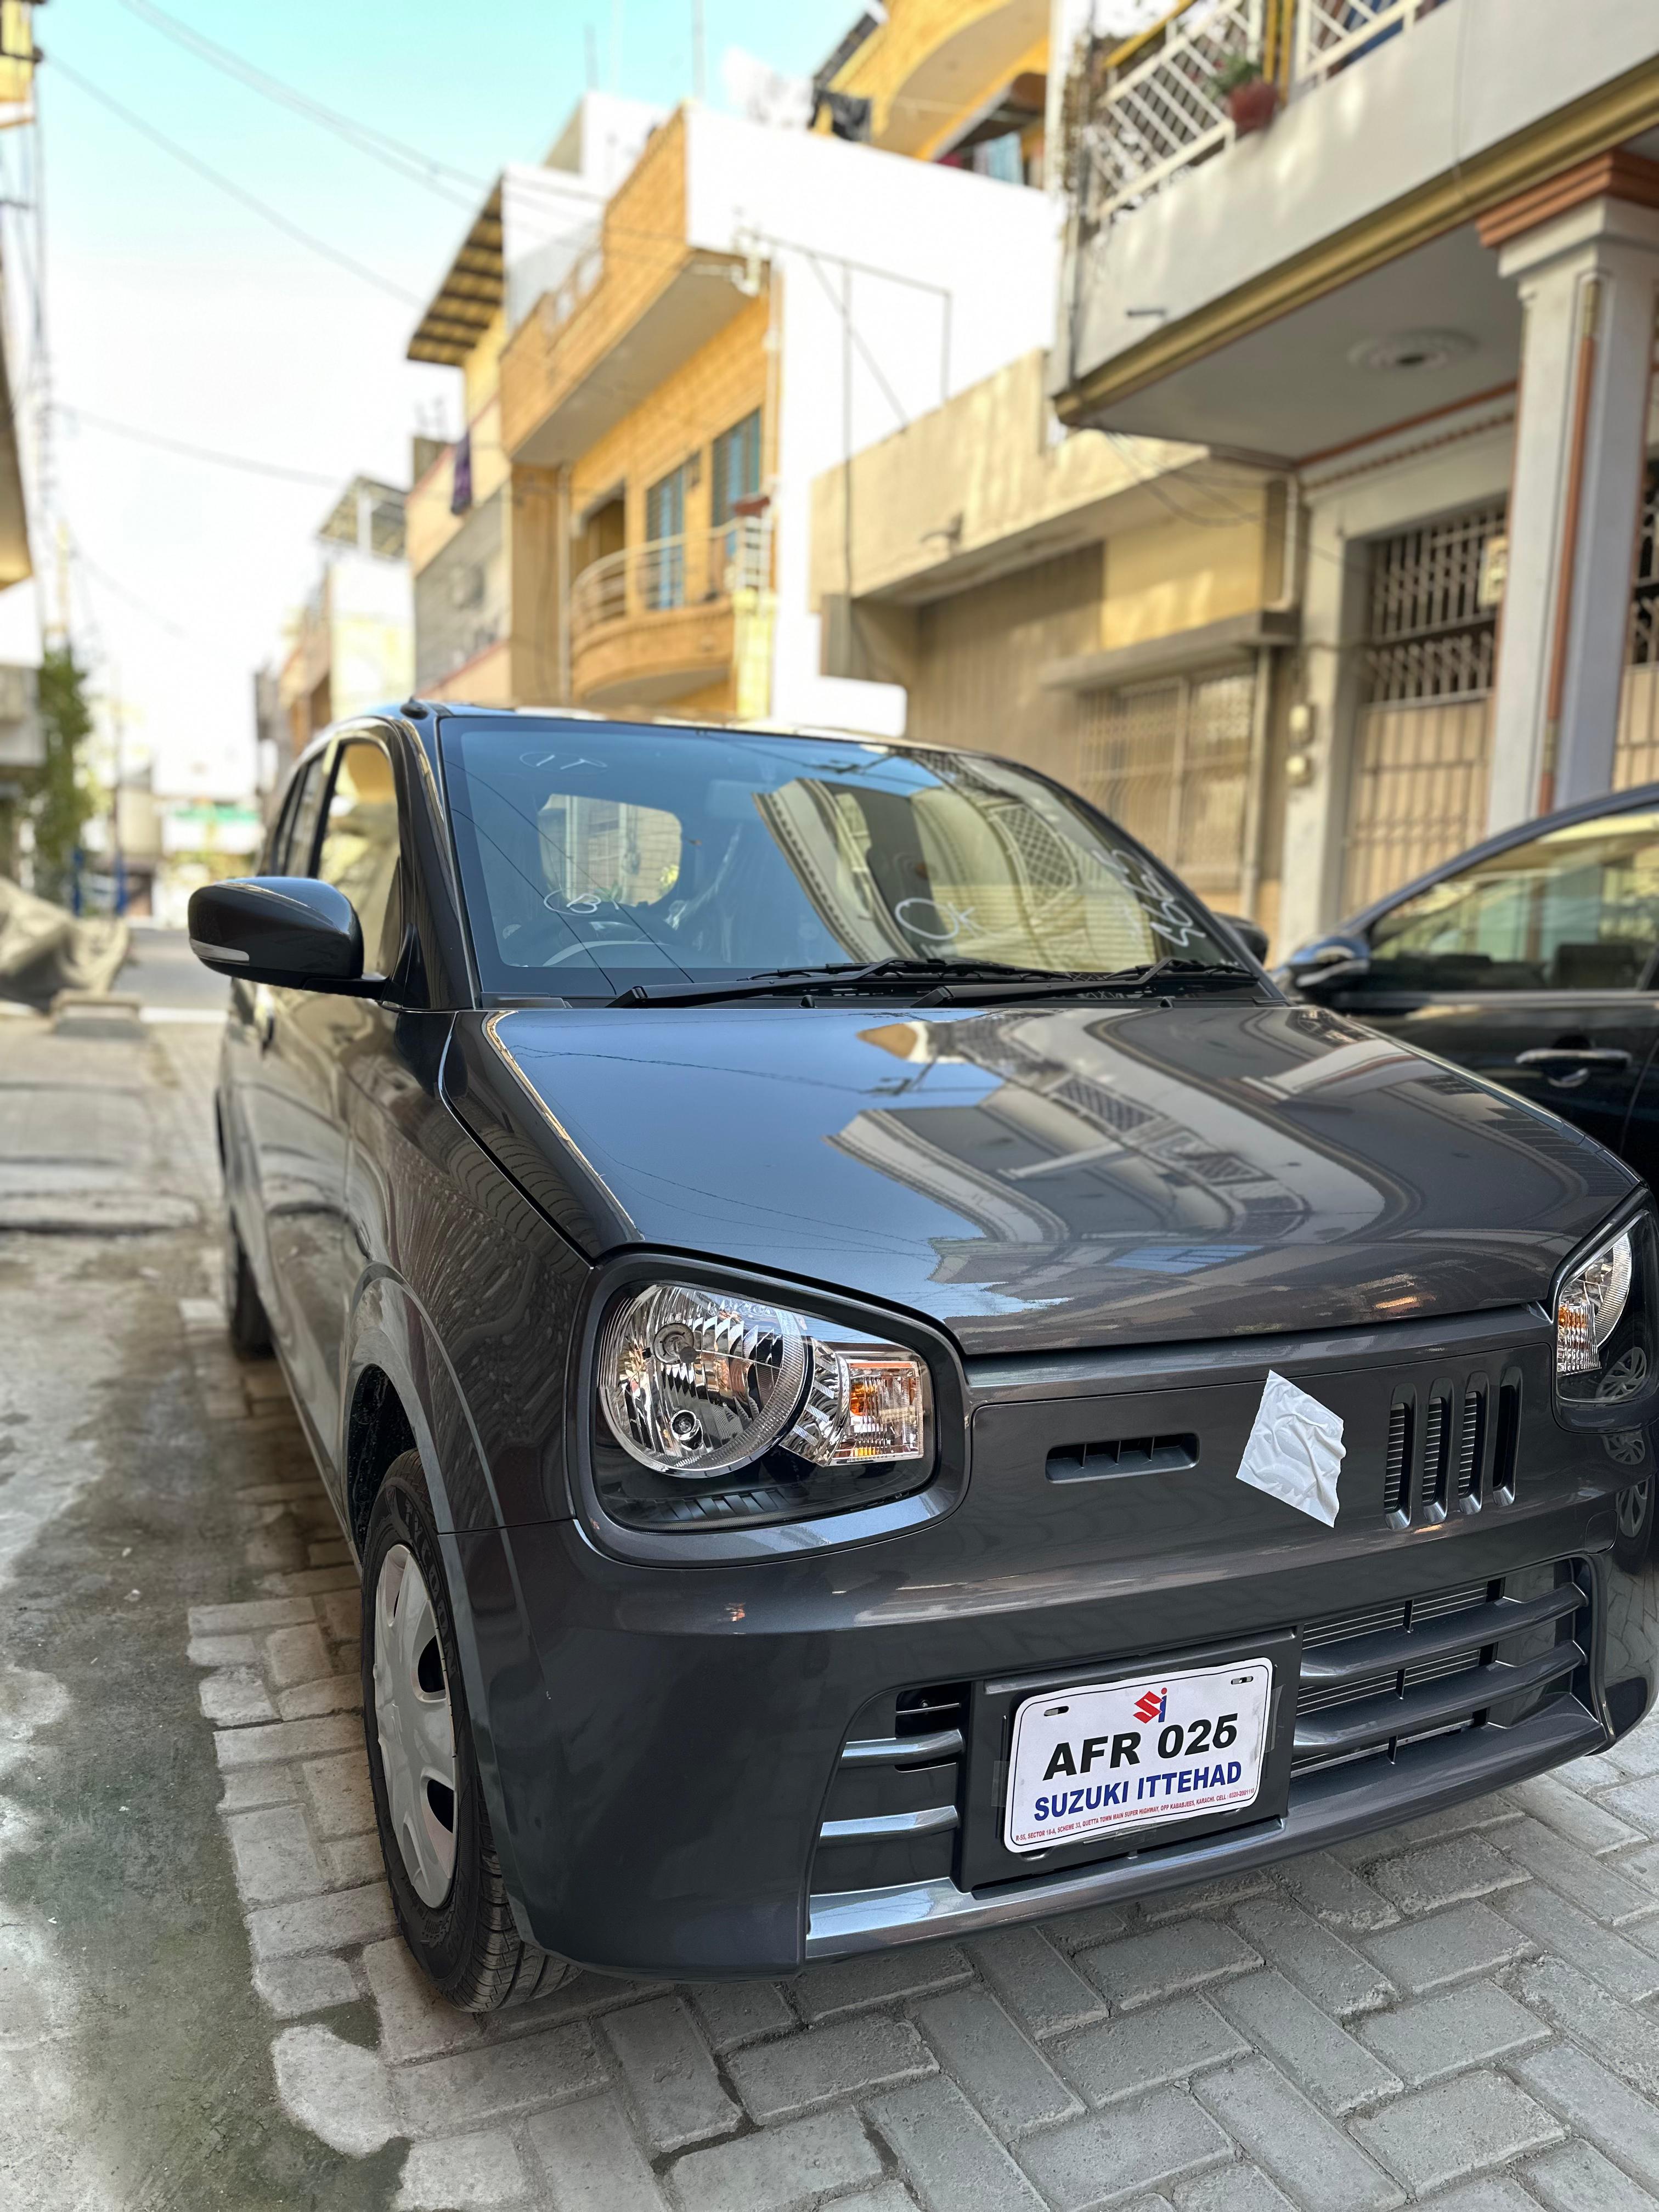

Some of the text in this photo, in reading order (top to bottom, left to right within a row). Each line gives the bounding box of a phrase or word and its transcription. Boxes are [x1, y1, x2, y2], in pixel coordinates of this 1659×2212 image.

[1042, 1731, 1141, 1781] AFR
[1034, 1761, 1242, 1821] SUZUKI ITTEHAD
[1028, 1831, 1046, 1839] SECTOR
[1057, 1825, 1074, 1833] SCHEME
[1082, 1819, 1099, 1827] QUETTA
[1099, 1815, 1112, 1823] TOWN
[1113, 1812, 1124, 1820] MAIN
[1124, 1809, 1138, 1818] SUPER
[1139, 1805, 1160, 1816] HIGHWAY,
